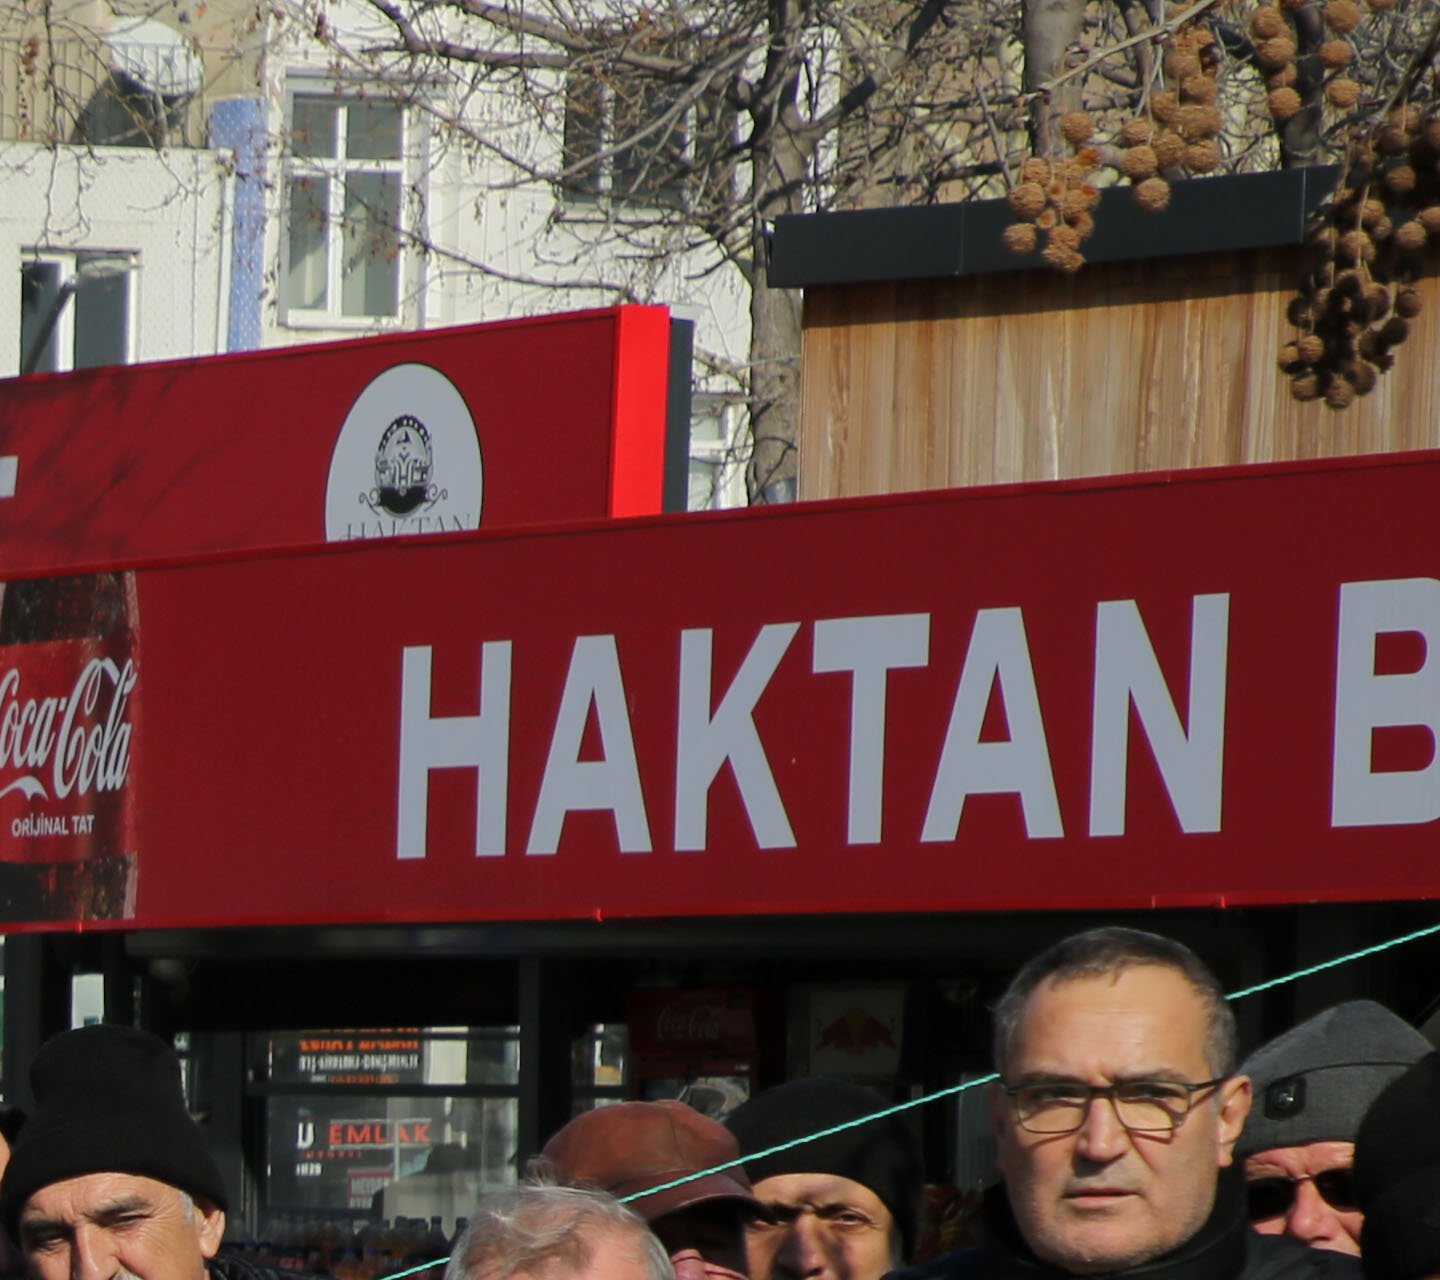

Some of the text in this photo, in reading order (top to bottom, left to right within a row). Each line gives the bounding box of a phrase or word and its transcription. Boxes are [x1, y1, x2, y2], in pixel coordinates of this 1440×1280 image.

[397, 593, 1230, 859] HAKTAN
[12, 812, 95, 837] ORİJİNAL TAT
